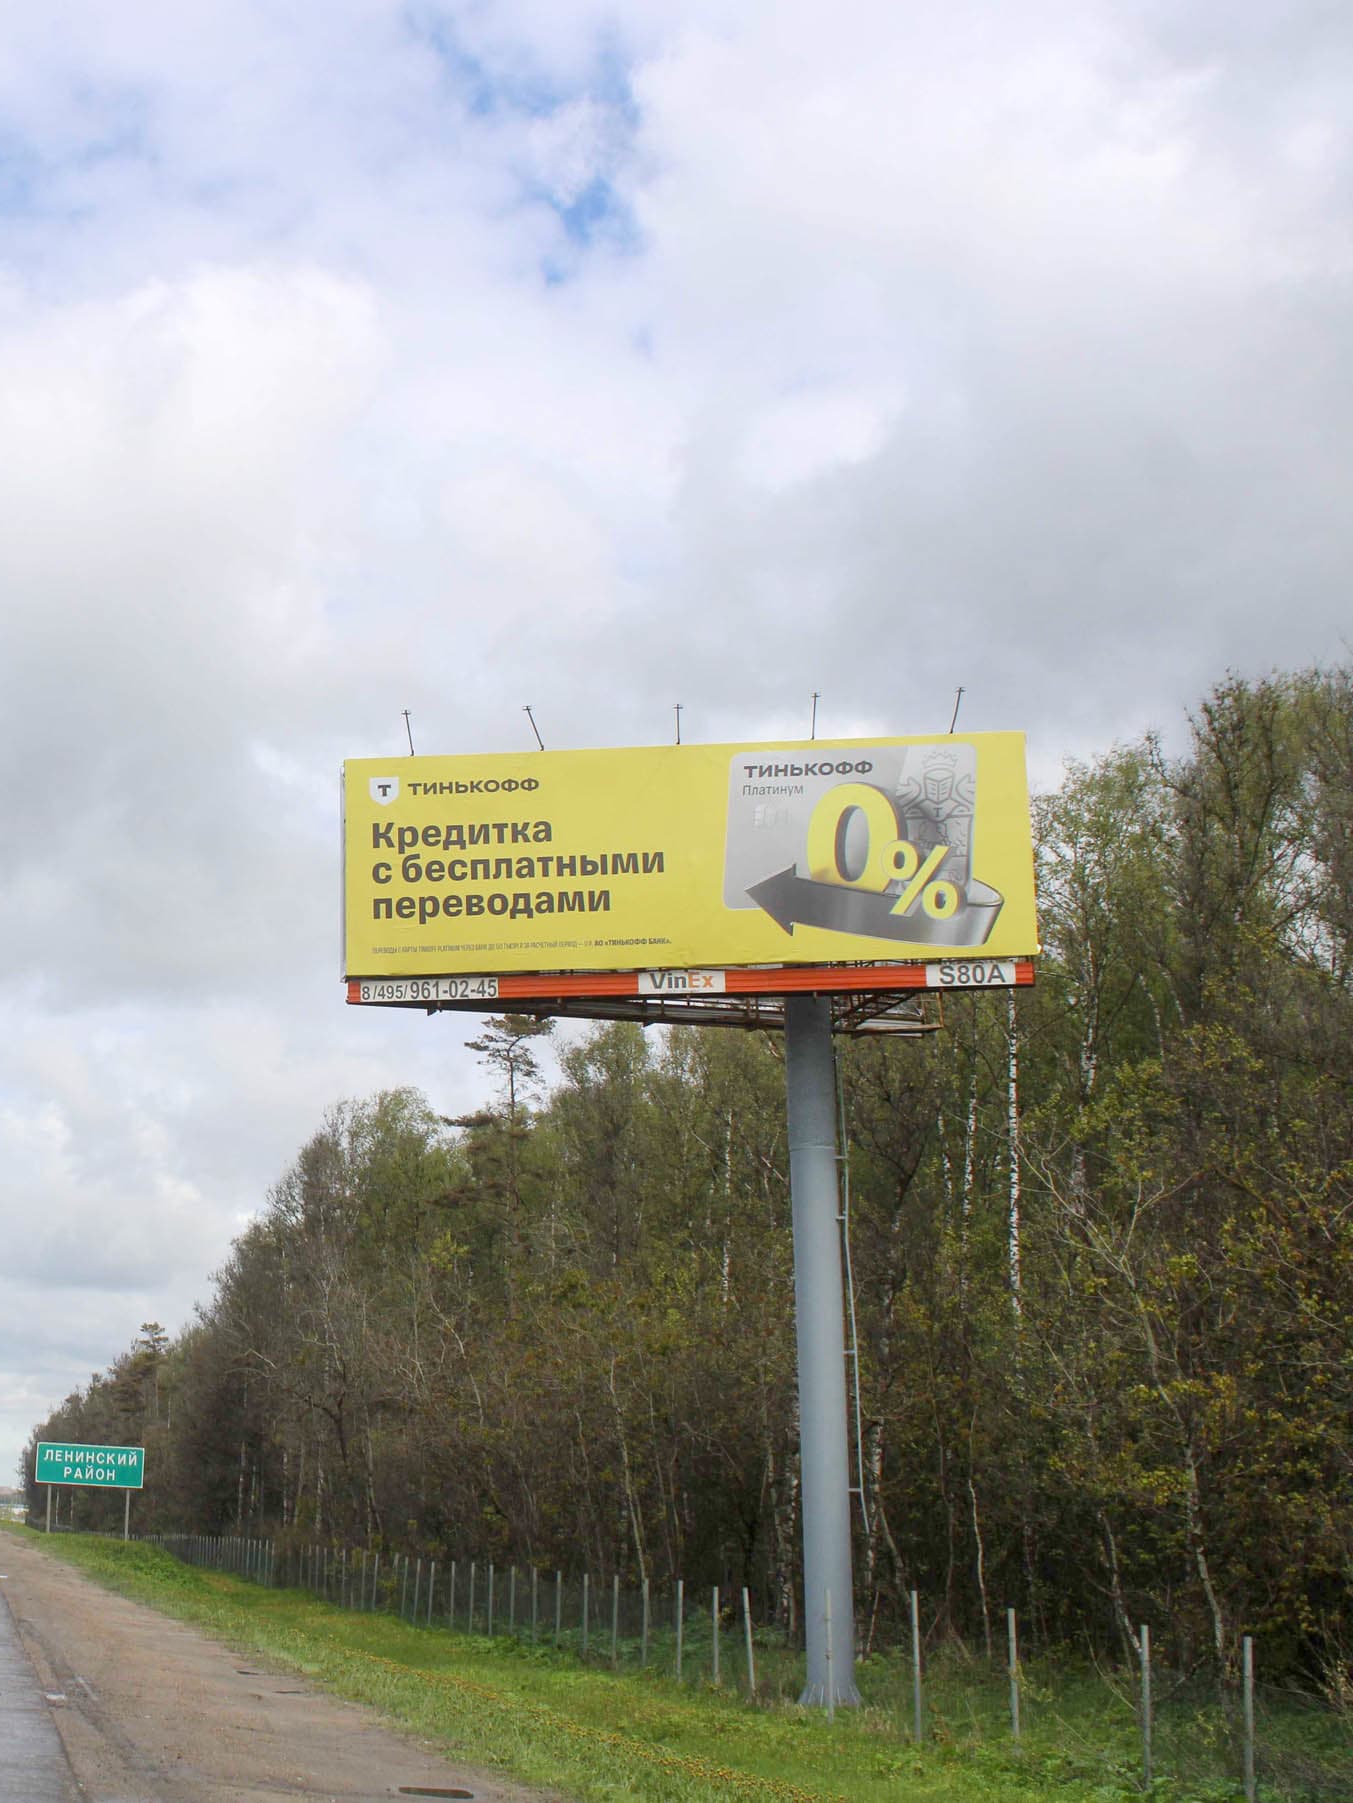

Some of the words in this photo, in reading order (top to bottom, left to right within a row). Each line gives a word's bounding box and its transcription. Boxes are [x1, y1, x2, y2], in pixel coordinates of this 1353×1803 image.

[743, 760, 874, 779] ТИНЬКОФФ
[407, 777, 540, 796] ТИНЬКОФФ
[742, 784, 804, 797] Платинум
[372, 820, 553, 854] Кредитка
[806, 782, 961, 920] 0%
[372, 862, 393, 884] с
[401, 852, 665, 883] бесплатными
[372, 890, 611, 925] переводами
[649, 972, 713, 989] VinEx
[939, 964, 1006, 985] S80A
[44, 1449, 137, 1466] ЛЕНИНСКИЙ
[63, 1465, 116, 1481] РАЙОН
